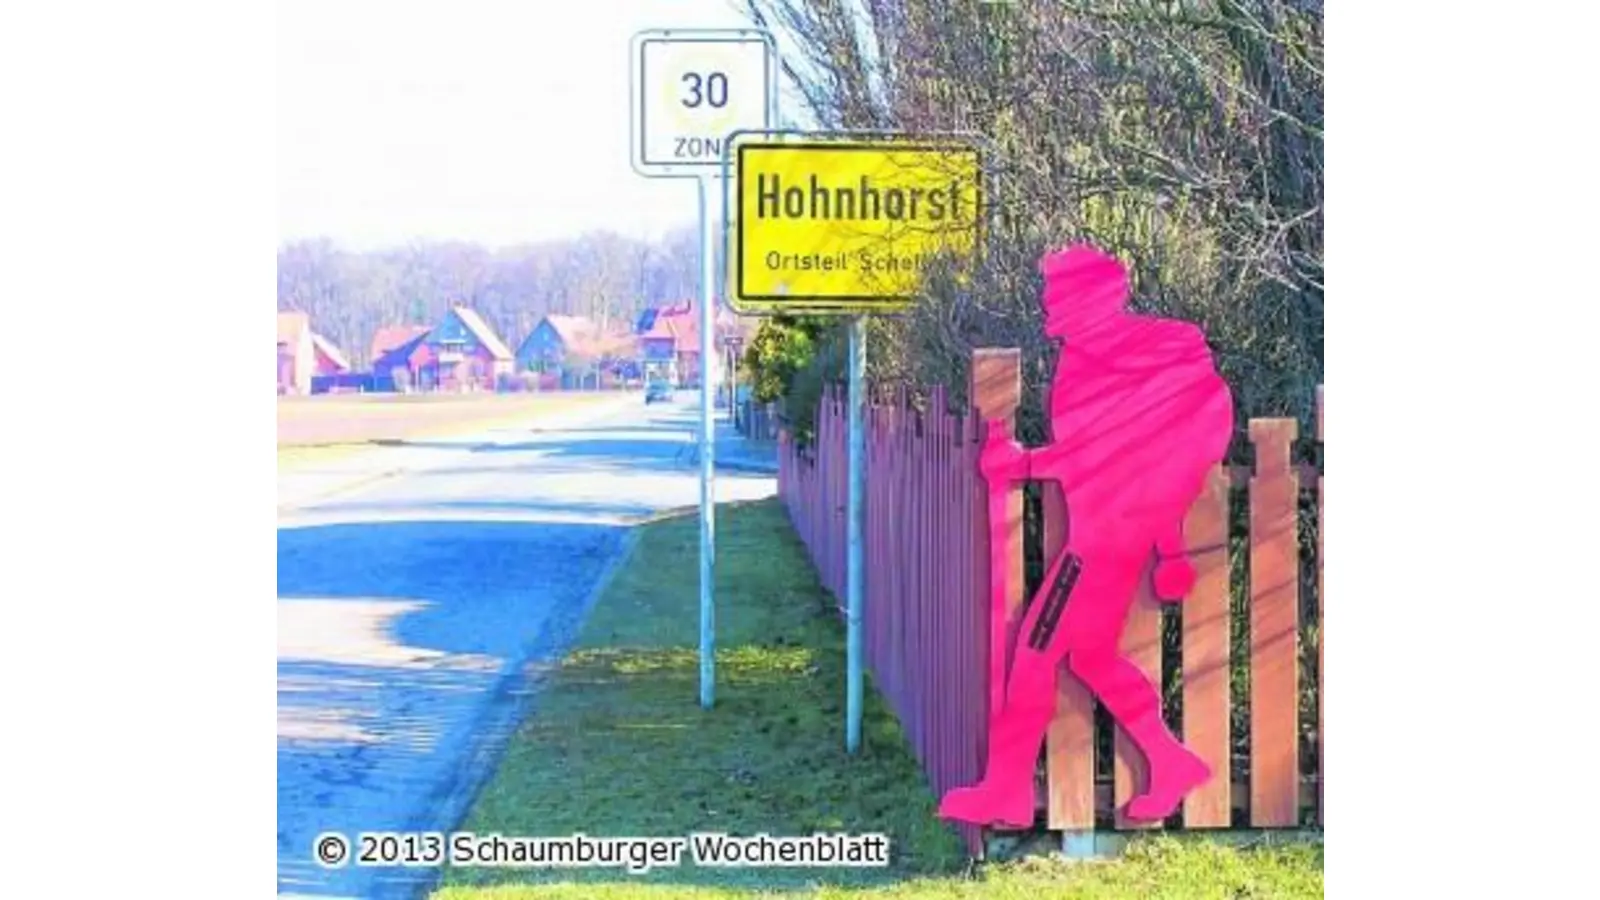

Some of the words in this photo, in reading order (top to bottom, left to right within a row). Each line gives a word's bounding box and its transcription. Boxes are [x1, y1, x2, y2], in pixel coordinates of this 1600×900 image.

[680, 72, 730, 109] 30
[673, 137, 731, 157] ZON
[757, 173, 961, 221] Hohnhorst
[766, 251, 847, 272] Ortsteil
